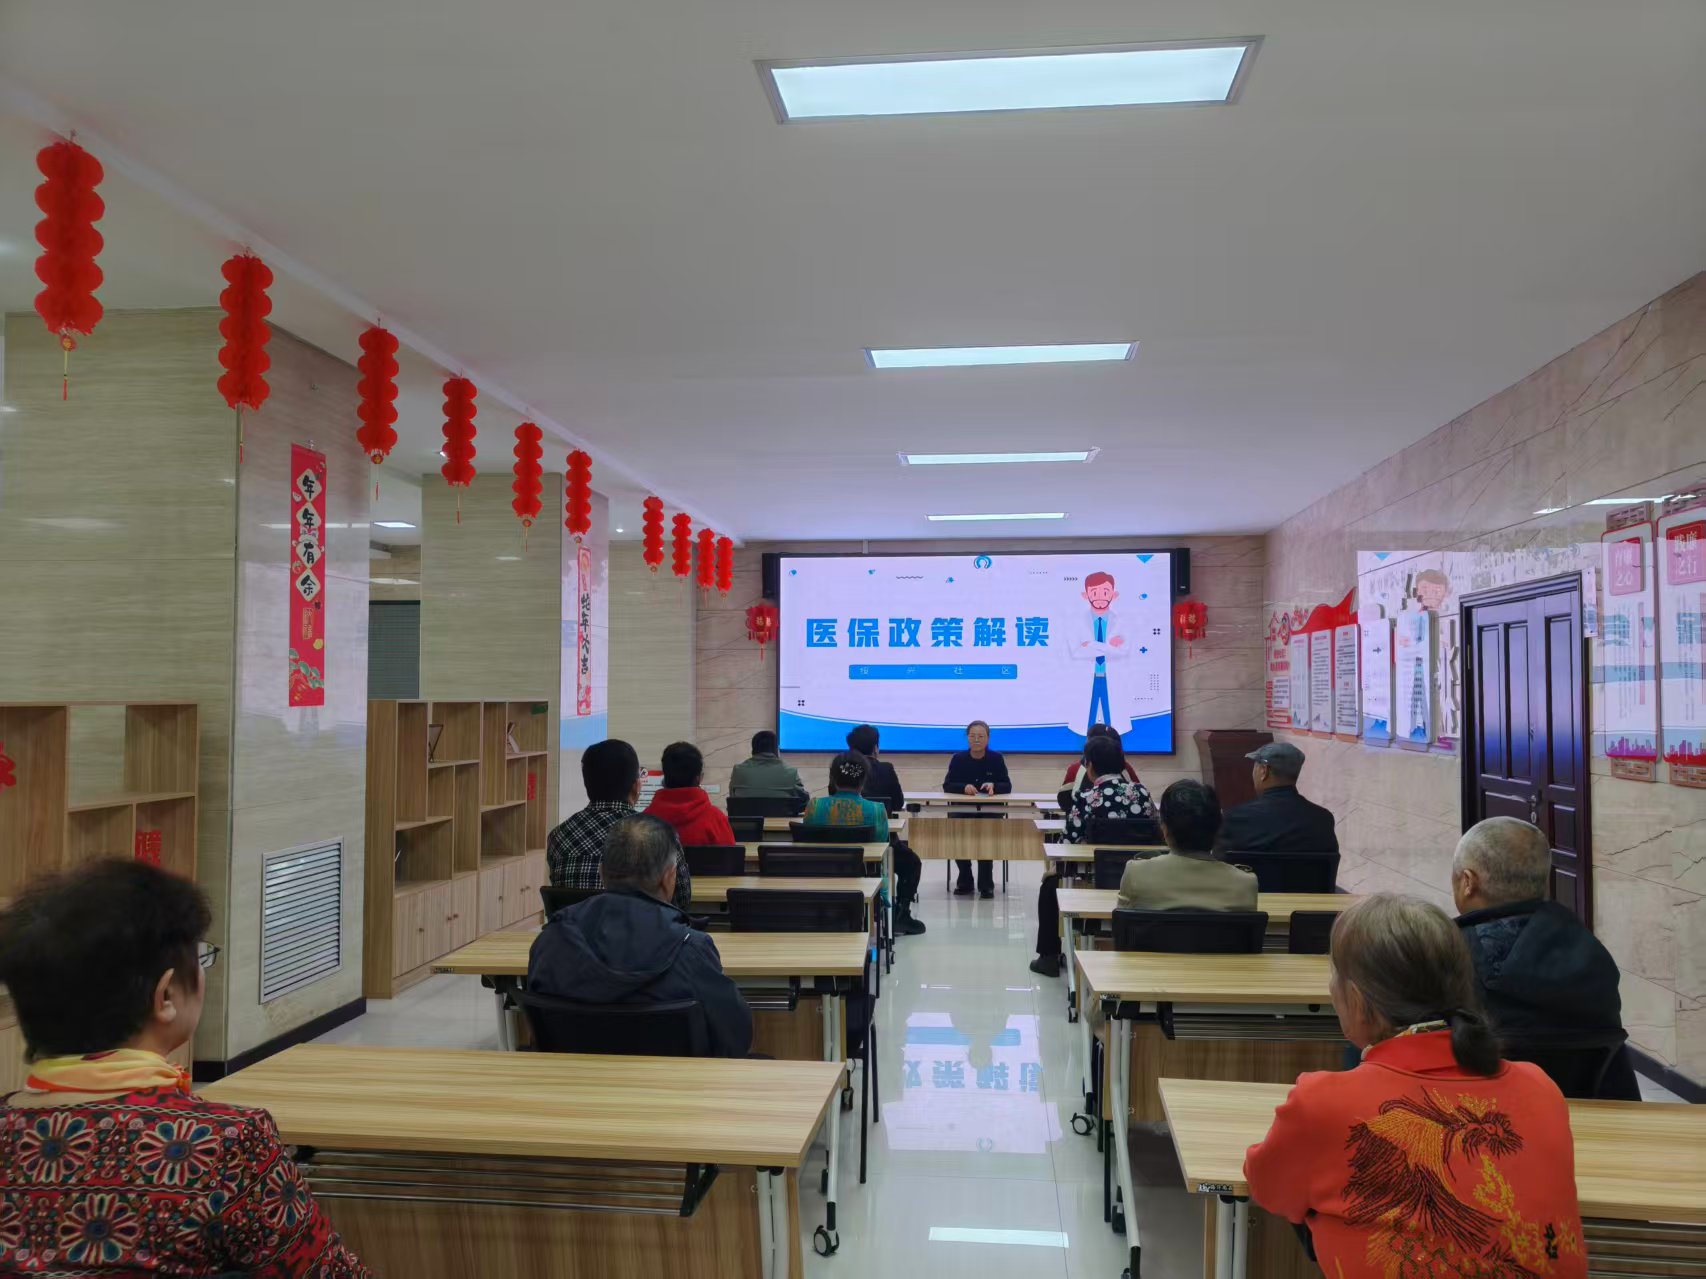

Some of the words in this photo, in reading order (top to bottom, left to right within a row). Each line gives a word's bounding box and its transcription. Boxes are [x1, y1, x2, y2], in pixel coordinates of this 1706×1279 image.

[299, 474, 318, 597] 年年有余
[806, 616, 1049, 647] 医保政策解读
